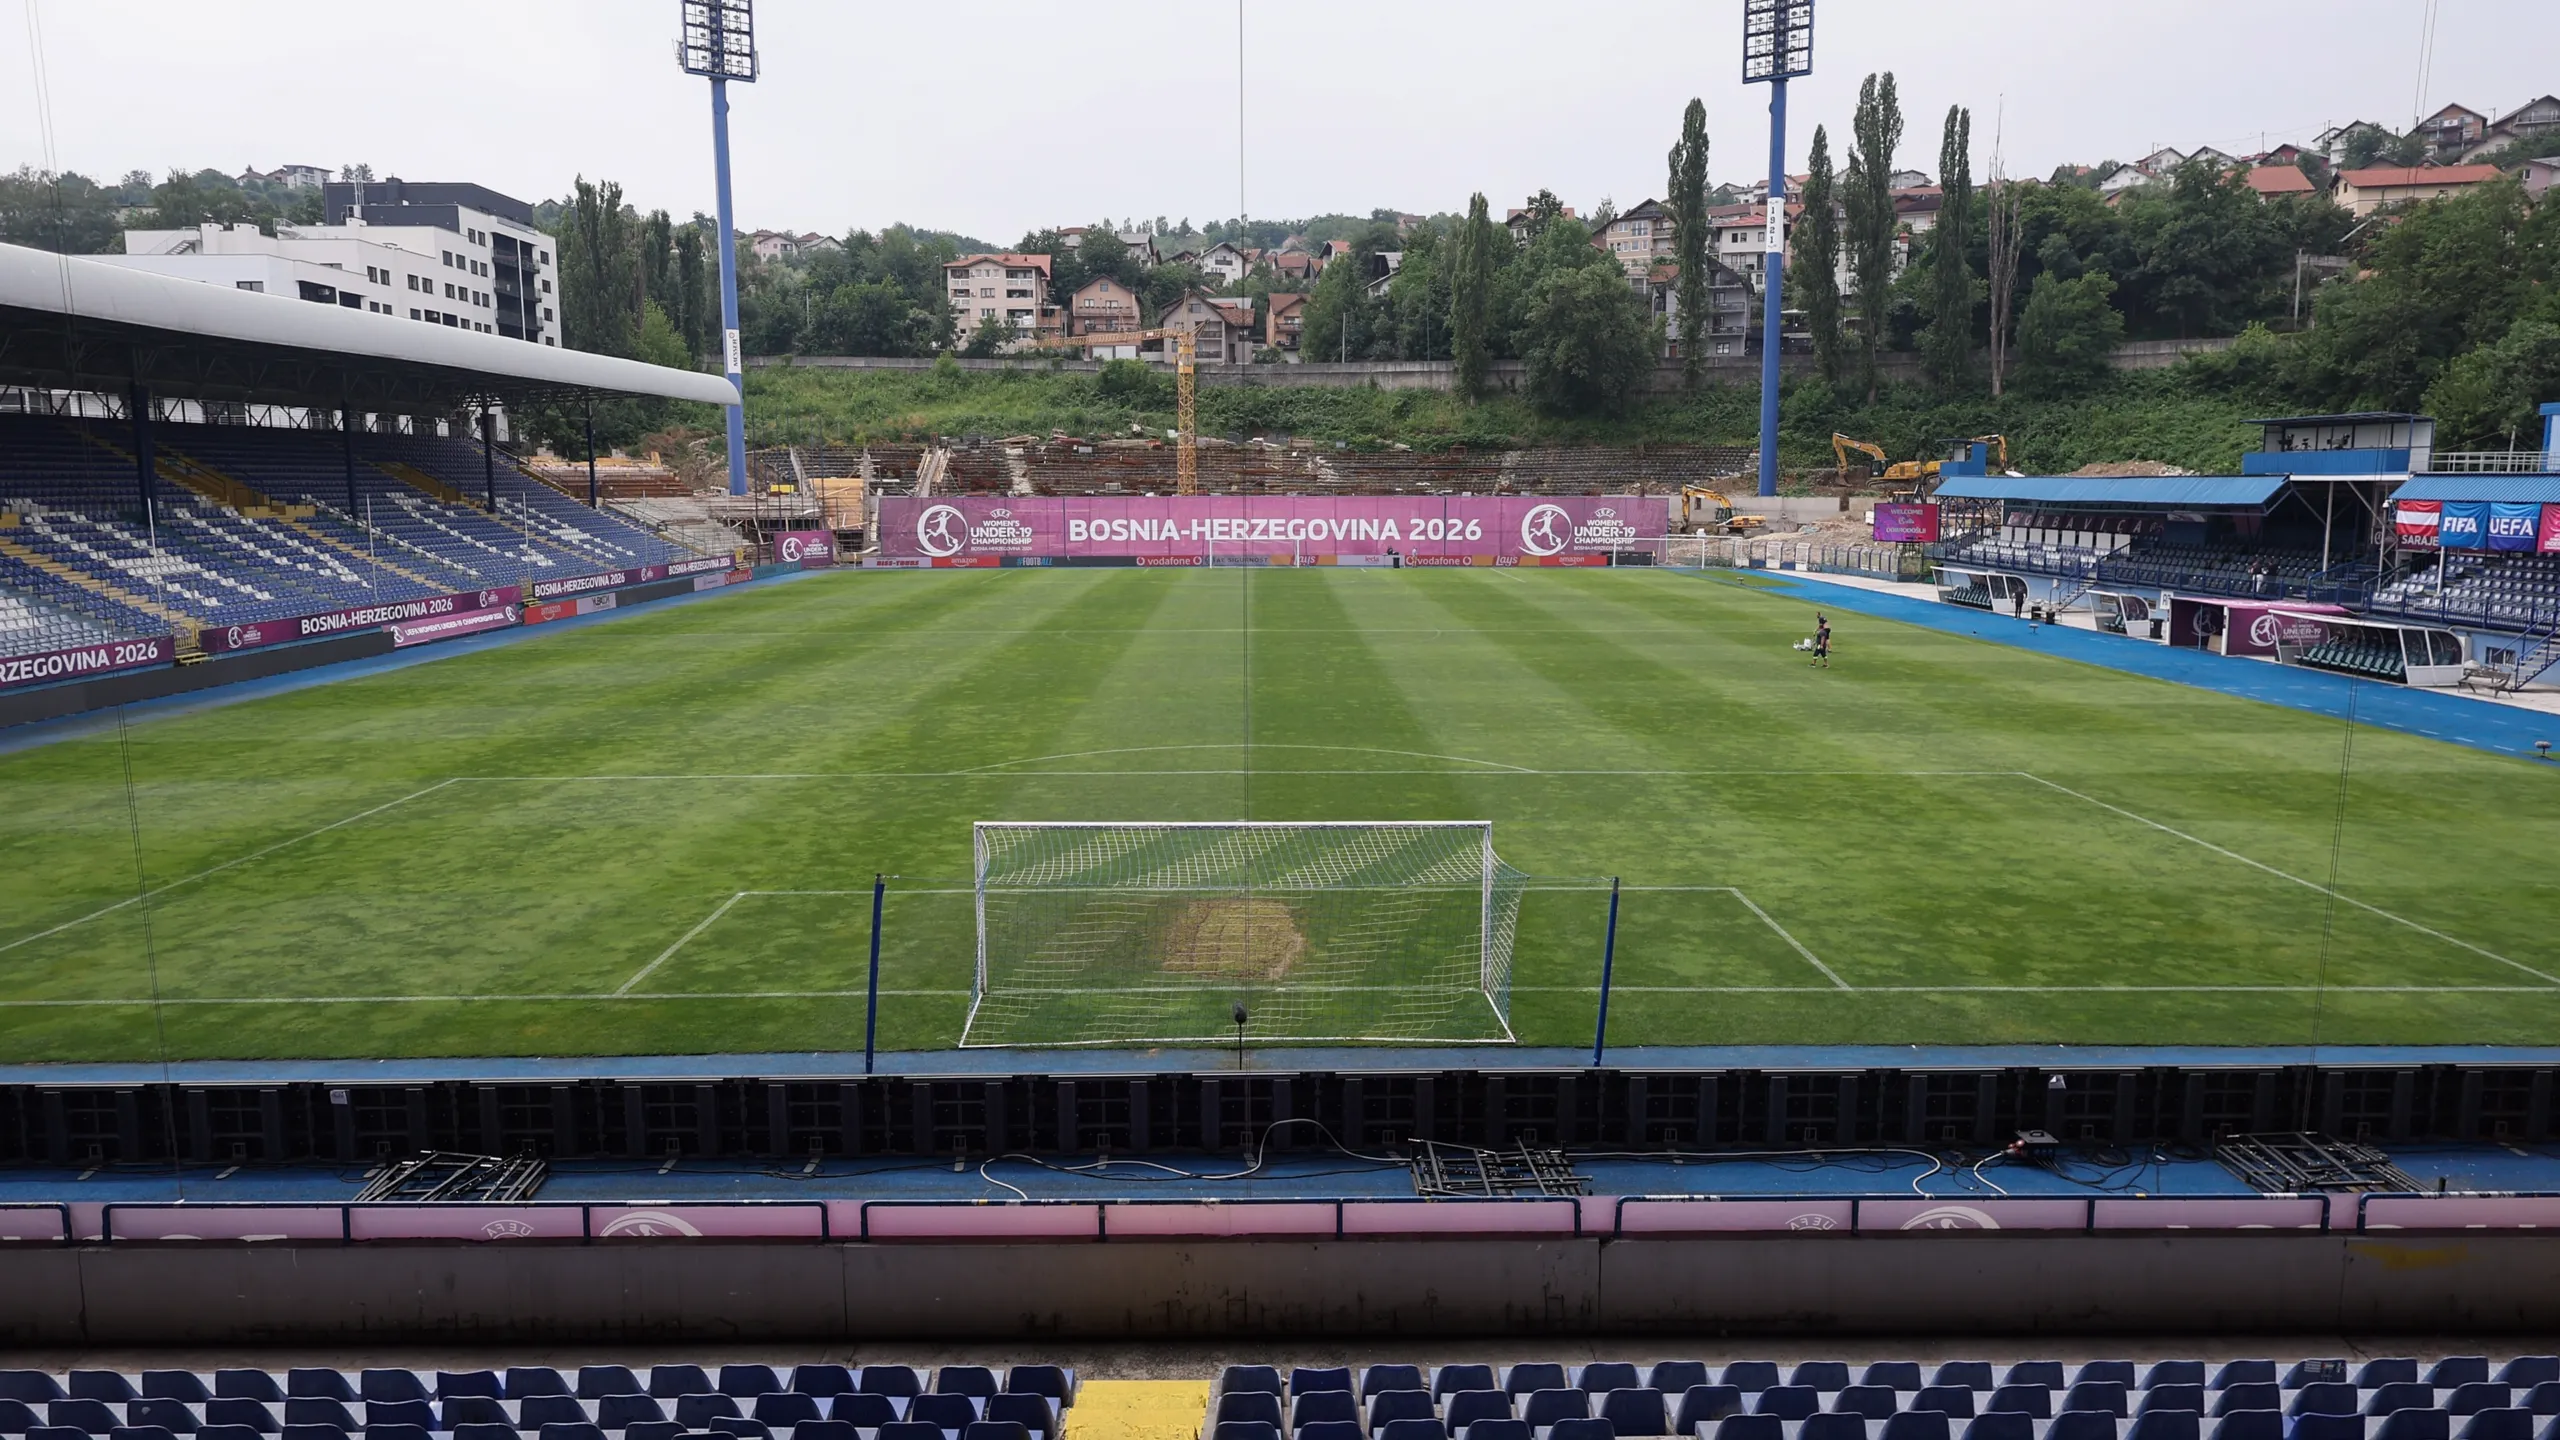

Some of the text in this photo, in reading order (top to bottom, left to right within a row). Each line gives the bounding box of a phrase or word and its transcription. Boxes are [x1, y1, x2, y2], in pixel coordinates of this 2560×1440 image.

[970, 527, 1032, 537] UNDER-19
[1069, 518, 1482, 541] BOSNIA-HERZEGOVINA 2026
[1574, 527, 1636, 537] UNDER-19
[2443, 517, 2477, 533] FIFA
[2489, 518, 2534, 536] UEFA
[668, 558, 719, 576] BOSNIA-HERZEGOVINA
[719, 557, 731, 567] 2026
[1016, 557, 1052, 566] #FOOTBALL
[1148, 556, 1190, 565] vodafone
[1418, 556, 1460, 565] vodafone
[730, 571, 748, 583] vodafone
[534, 577, 610, 607] BOSNIA-HERZEGOVINA
[610, 573, 626, 585] 2026
[301, 598, 453, 635] BOSNIA-HERZEGOVINA 2026
[462, 614, 493, 626] CHAMPIONSHIP
[114, 641, 158, 664] 2026
